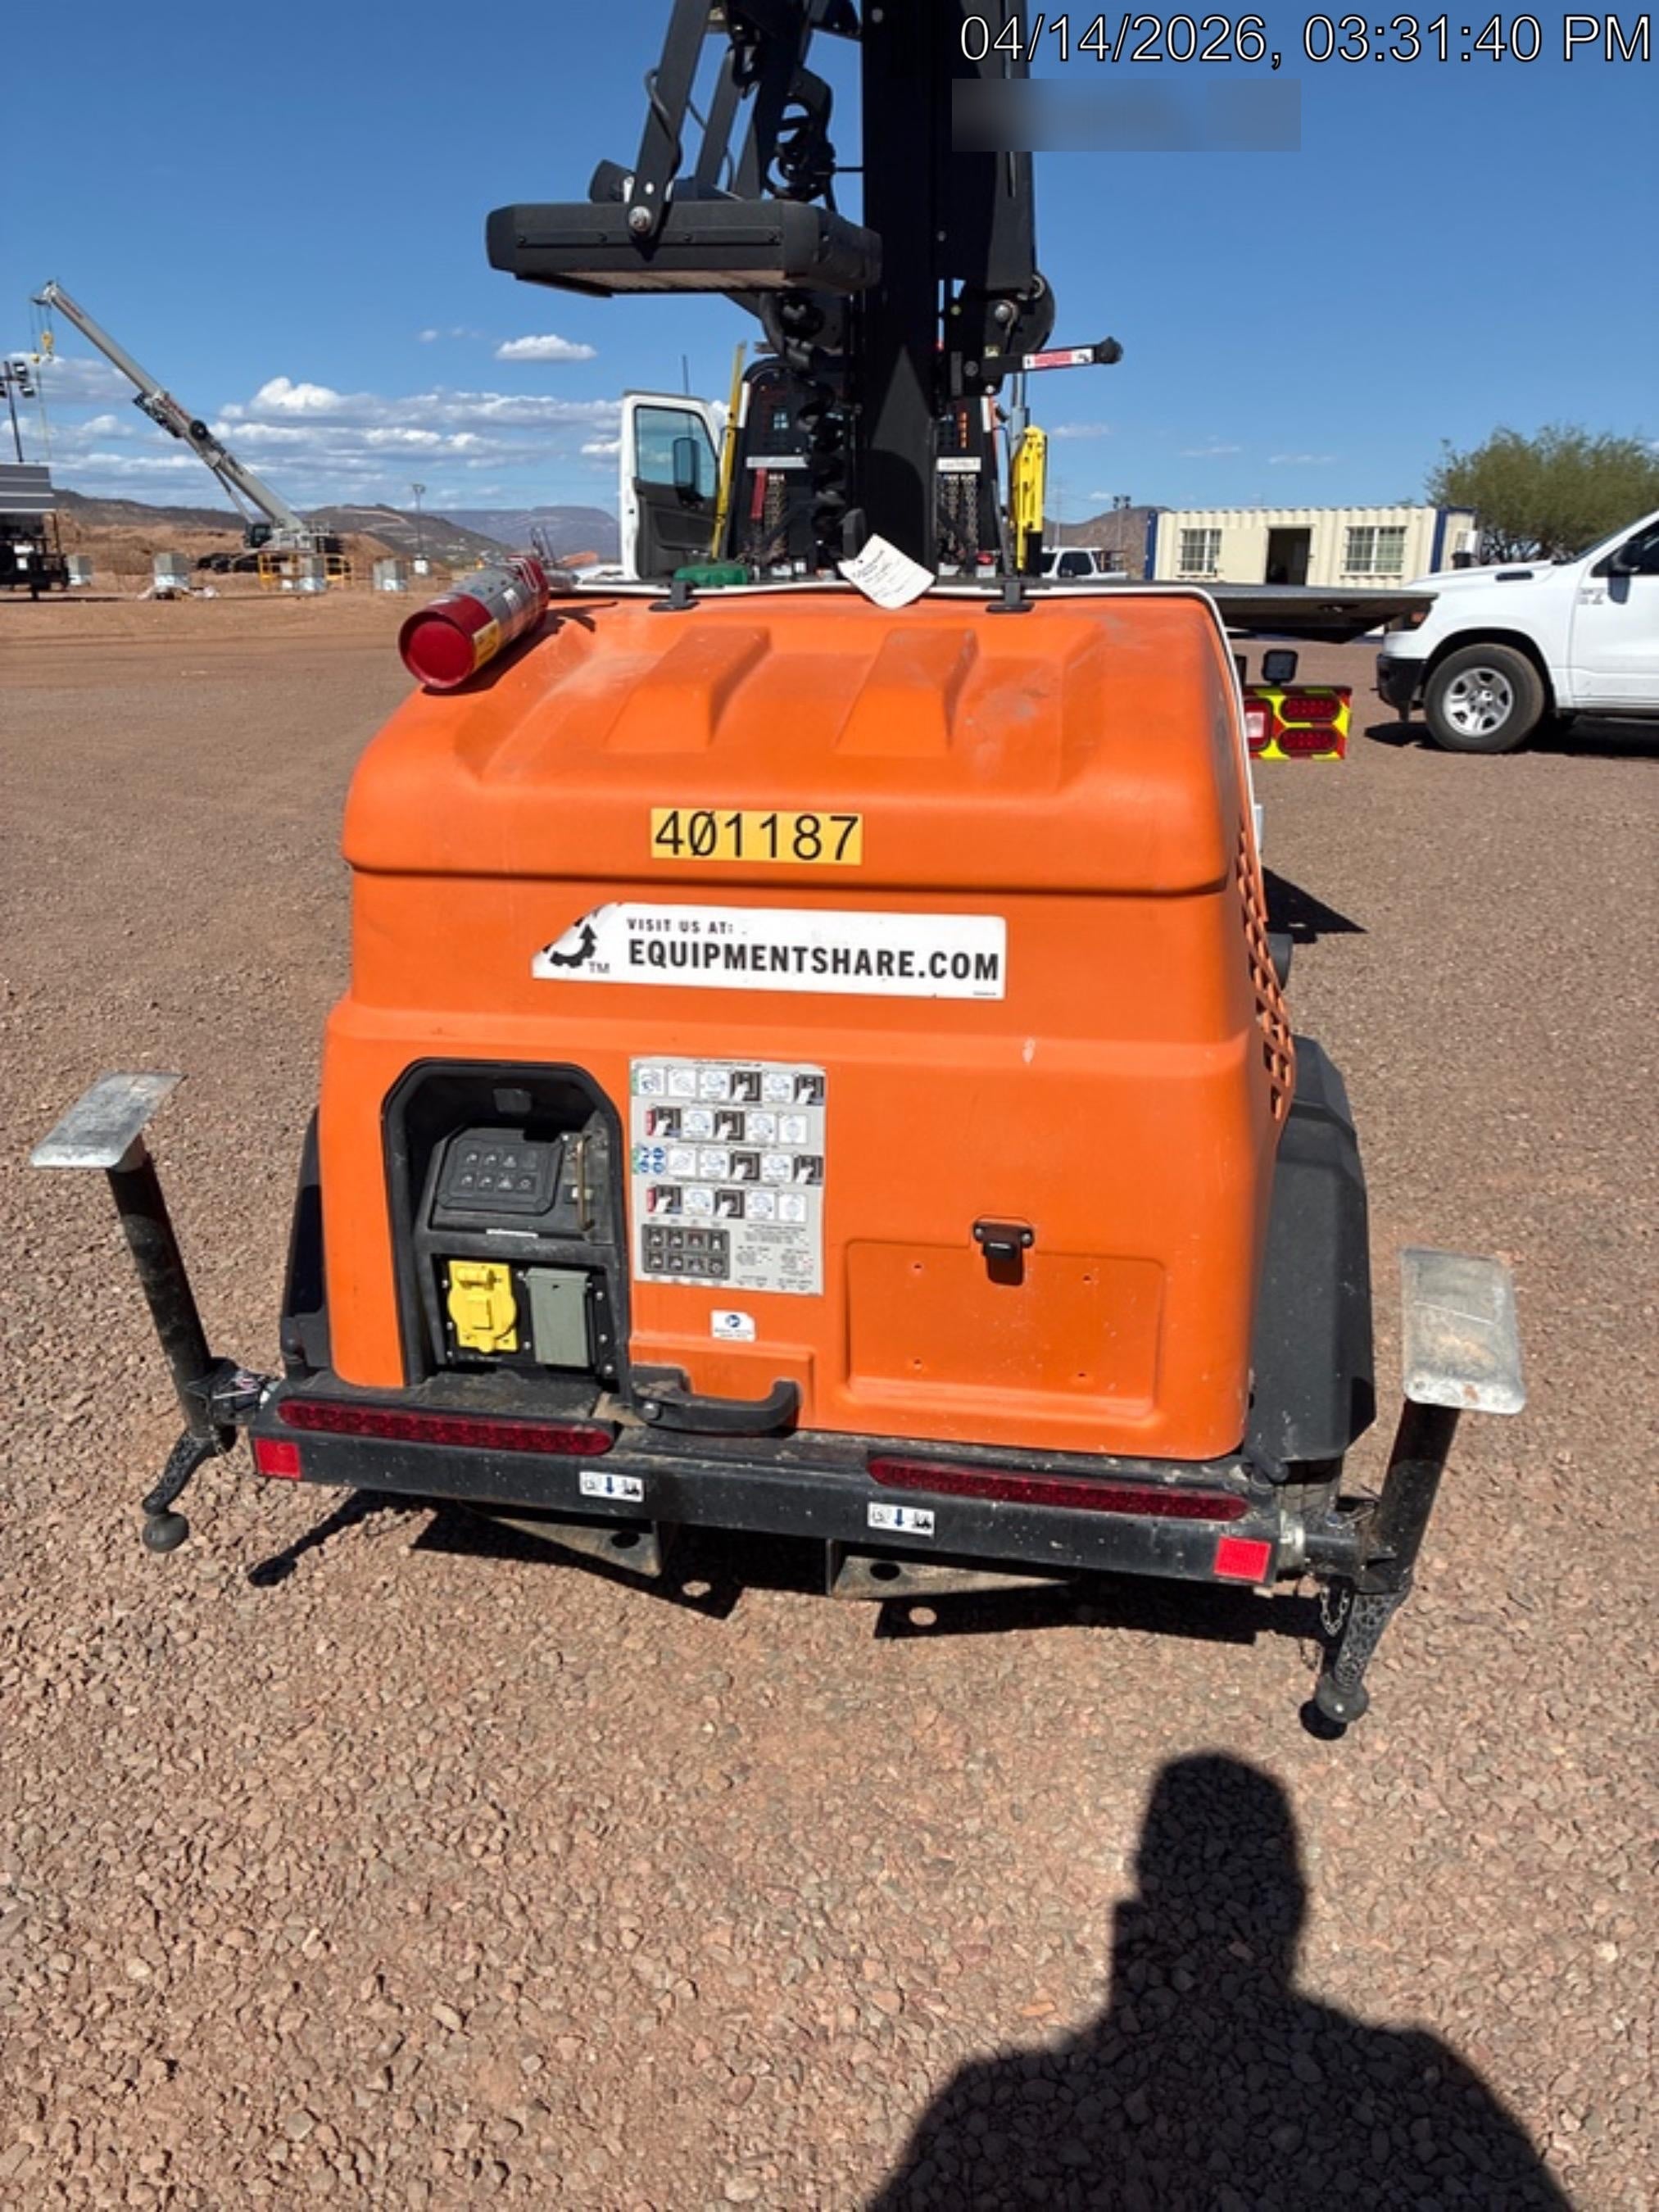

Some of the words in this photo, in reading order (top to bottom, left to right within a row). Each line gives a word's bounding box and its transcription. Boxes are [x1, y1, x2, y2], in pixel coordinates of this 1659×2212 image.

[654, 809, 859, 861] 401187
[626, 917, 672, 933] VISIT
[678, 920, 701, 934] US
[707, 921, 734, 936] AT:
[628, 938, 999, 981] EQUIPMENTSHARE.COM
